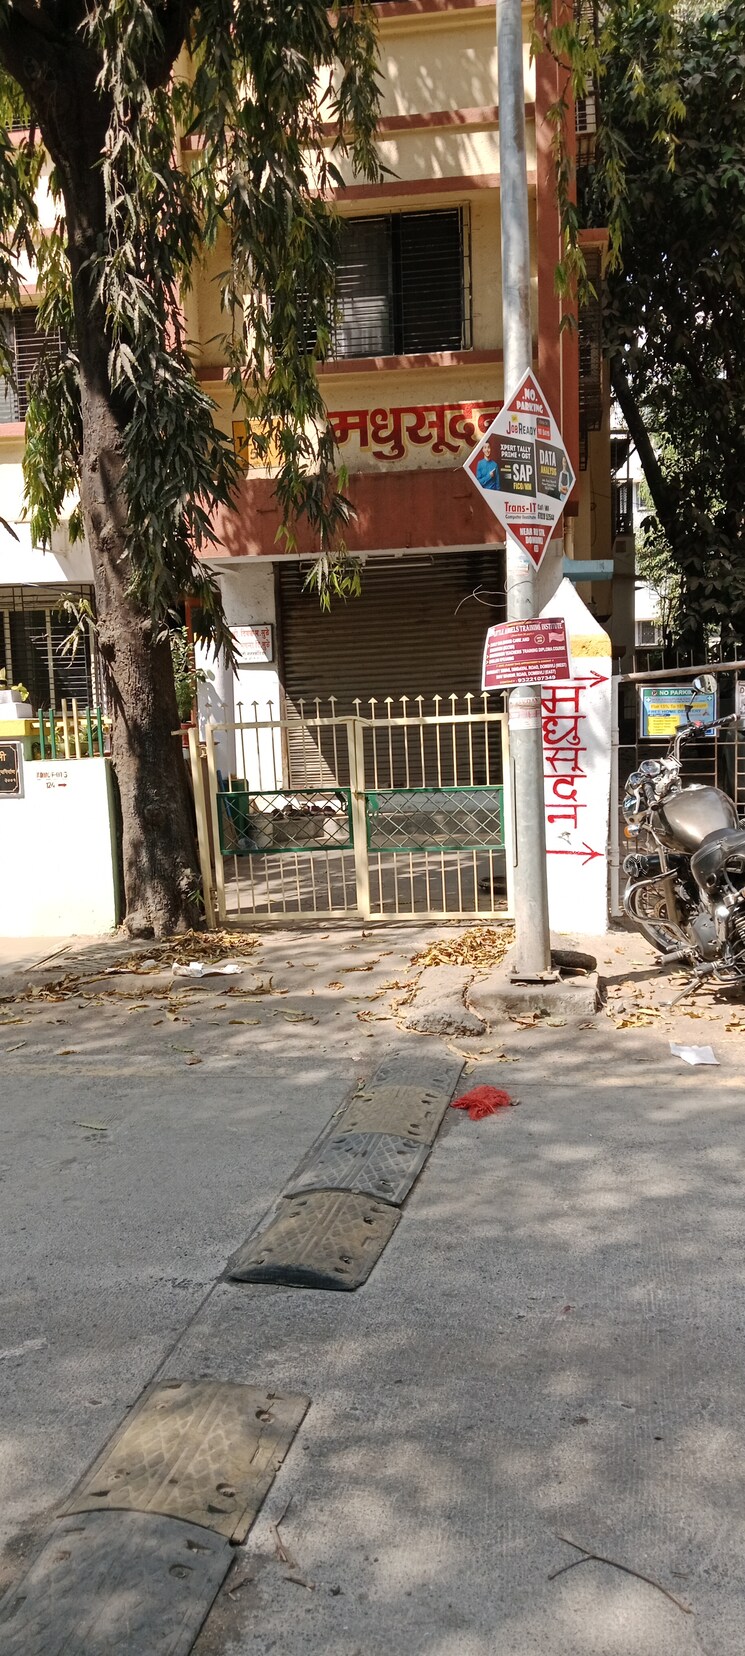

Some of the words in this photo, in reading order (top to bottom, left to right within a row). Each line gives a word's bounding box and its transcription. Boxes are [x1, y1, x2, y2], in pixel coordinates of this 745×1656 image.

[516, 401, 543, 413] PARKING
[500, 444, 516, 452] XPERT
[501, 450, 517, 458] PRIME
[539, 449, 557, 467] DATA
[512, 463, 533, 482] SAP
[504, 501, 536, 513] Trans-IT
[520, 527, 533, 536] NEAR
[541, 622, 563, 630] INSTITUTE
